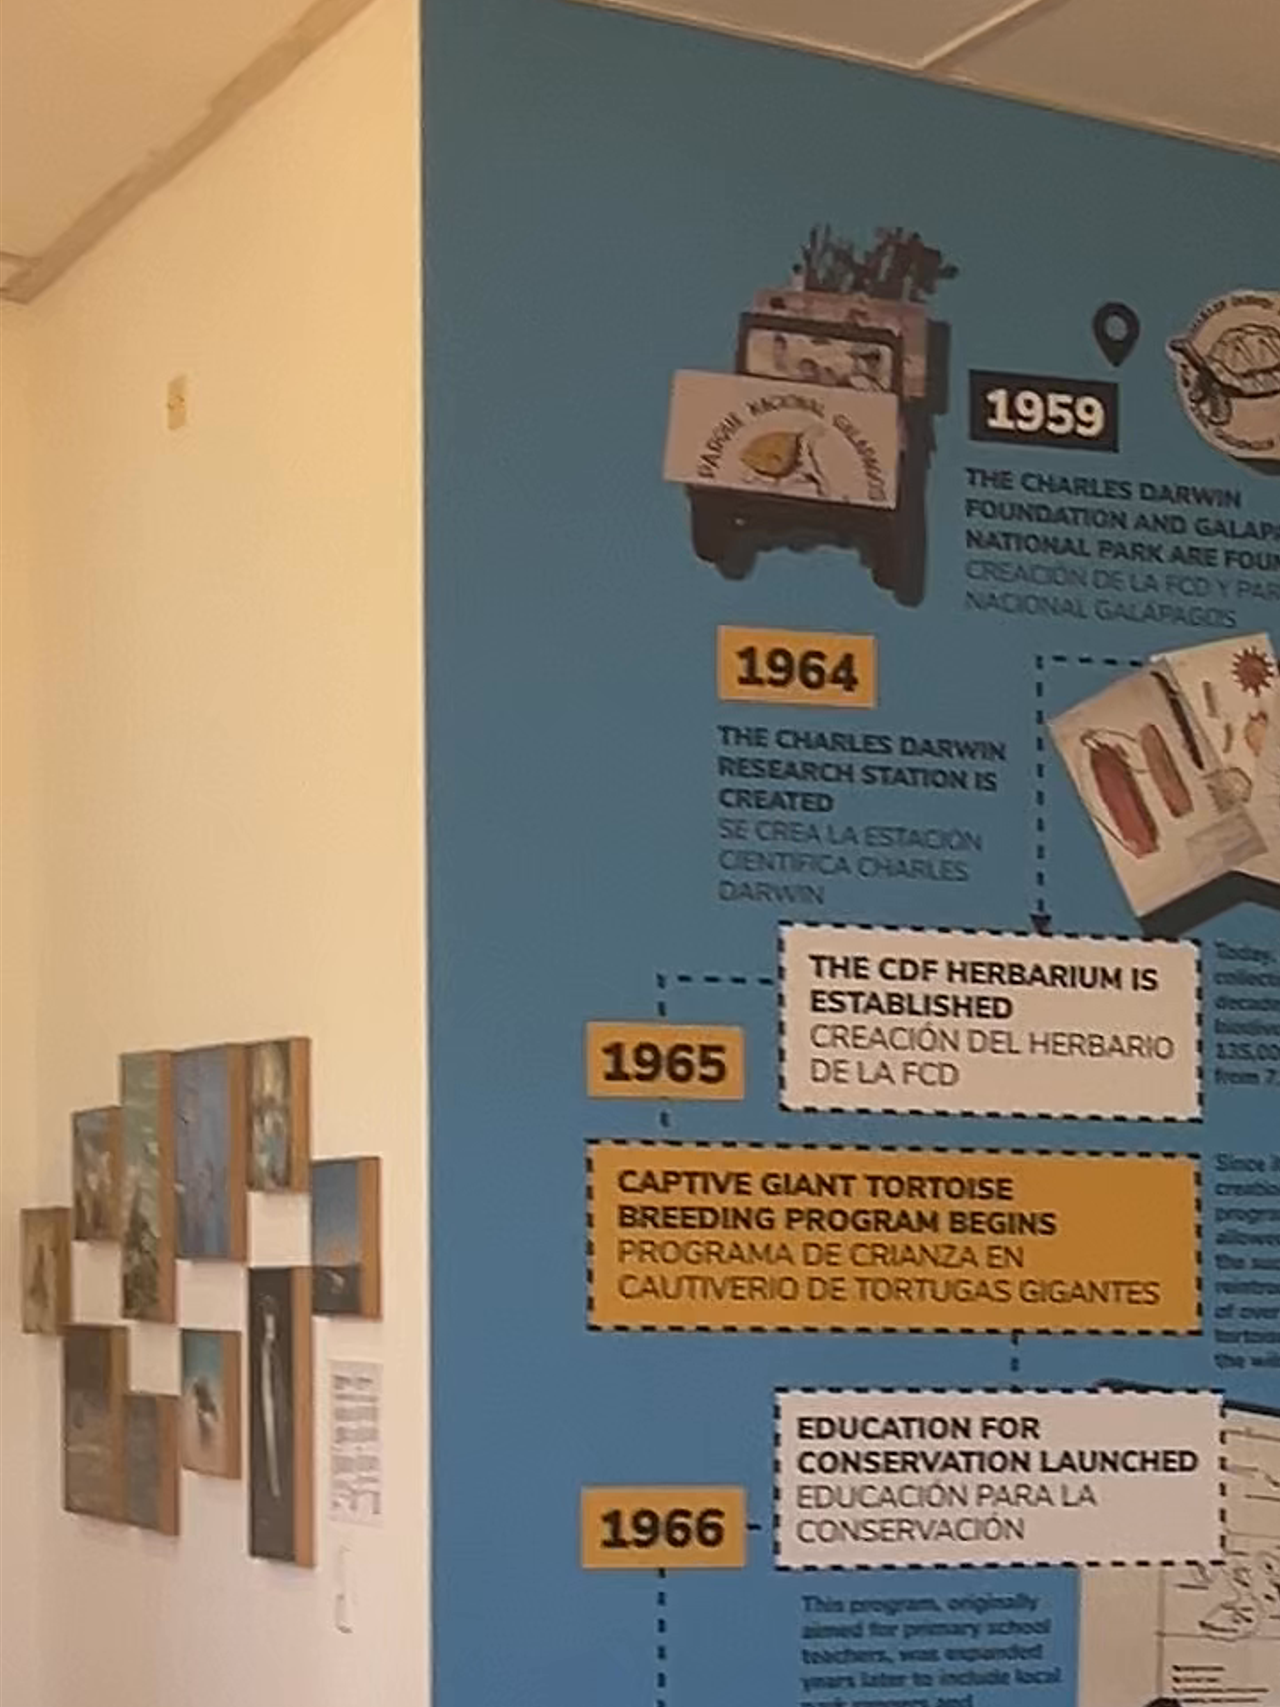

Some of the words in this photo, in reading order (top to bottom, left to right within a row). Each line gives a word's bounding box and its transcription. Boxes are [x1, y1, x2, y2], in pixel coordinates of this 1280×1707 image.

[988, 388, 1104, 438] 1959
[966, 469, 1013, 493] THE
[1021, 472, 1132, 501] CHARLES
[1139, 480, 1241, 508] DARWIN
[965, 500, 1127, 532] FOUNDATION
[1134, 511, 1186, 536] AND
[966, 531, 1091, 560] NATIONAL
[1098, 539, 1163, 565] PARK
[1170, 544, 1217, 568] ARE
[738, 647, 858, 691] 1964
[718, 727, 768, 751] THE
[776, 729, 892, 756] CHARLES
[900, 735, 1005, 761] DARWIN
[718, 758, 854, 785] RESEARCH
[862, 765, 967, 791] STATION
[975, 770, 997, 792] IS
[719, 790, 833, 813] CREATED
[810, 956, 869, 981] THE
[879, 959, 937, 983] CDF
[948, 961, 1121, 989] HERBARIUM
[1132, 968, 1158, 990] IS
[811, 991, 1012, 1019] ESTABLISHED
[810, 1024, 959, 1053] CREACIÓN
[968, 1031, 1021, 1055] DEL
[1030, 1033, 1174, 1059] HERBARIO
[603, 1041, 726, 1083] 1965
[811, 1061, 848, 1084] DE
[858, 1062, 895, 1085] LA
[903, 1063, 959, 1086] FCD
[618, 1170, 752, 1195] CAPTIVE
[761, 1173, 856, 1198] GIANT
[865, 1176, 1013, 1201] TORTOISE
[619, 1206, 774, 1231] BREEDING
[786, 1209, 938, 1234] PROGRAM
[949, 1212, 1056, 1236] BEGINS
[618, 1242, 794, 1266] PROGRAMA
[803, 1244, 841, 1267] DE
[850, 1245, 978, 1268] CRIANZA
[987, 1247, 1023, 1269] EN
[618, 1277, 798, 1301] CAUTIVERIO
[808, 1279, 846, 1302] DE
[857, 1279, 1012, 1304] TORTUGAS
[1019, 1281, 1160, 1305] GIGANTES
[798, 1418, 970, 1439] EDUCATION
[982, 1418, 1039, 1439] FOR
[798, 1451, 1030, 1473] CONSERVATION
[1041, 1451, 1198, 1472] LAUNCHED
[798, 1479, 967, 1508] EDUCACIÓN
[977, 1484, 1054, 1507] PARA
[1062, 1484, 1097, 1507] LA
[602, 1509, 724, 1549] 1966
[797, 1513, 1024, 1543] CONSERVACIÓN
